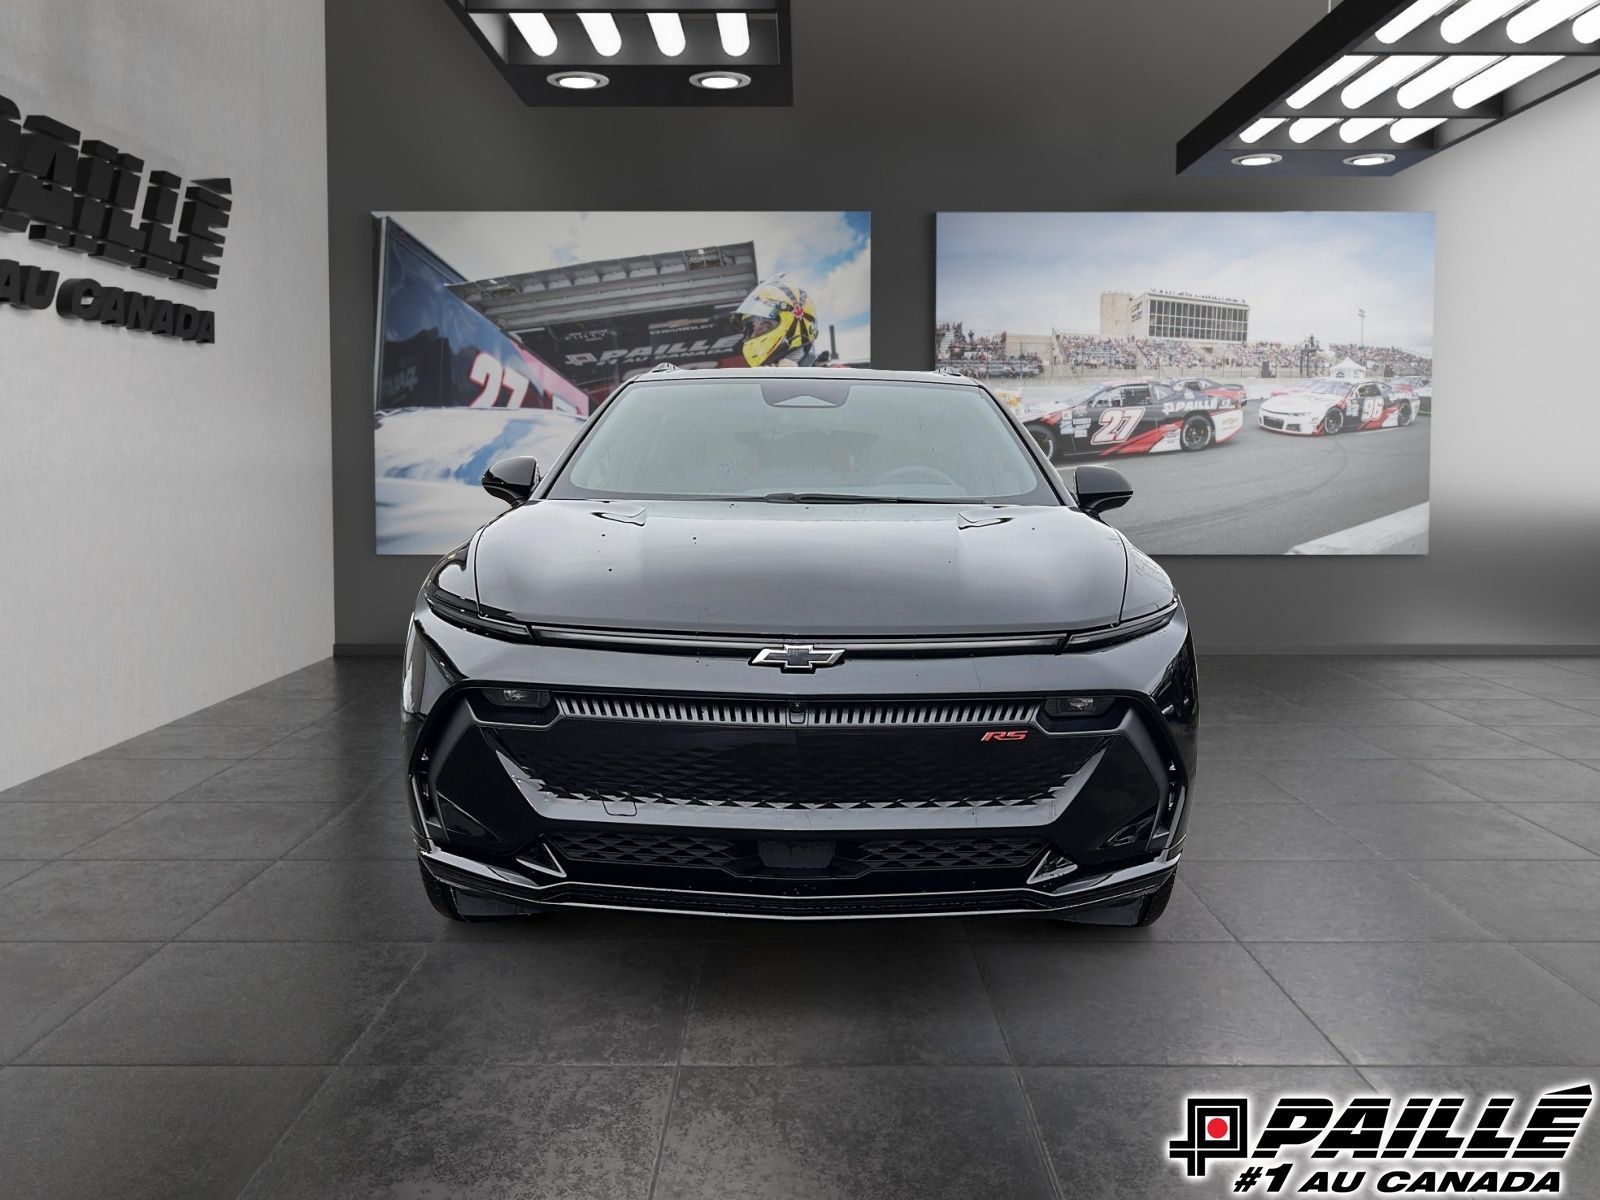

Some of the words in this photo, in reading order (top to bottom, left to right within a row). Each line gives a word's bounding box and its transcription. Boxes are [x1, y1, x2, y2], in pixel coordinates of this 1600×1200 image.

[56, 278, 215, 344] CANADA
[469, 351, 530, 409] 27
[1091, 406, 1146, 446] 27
[1361, 396, 1385, 422] 96
[981, 730, 1029, 741] RS
